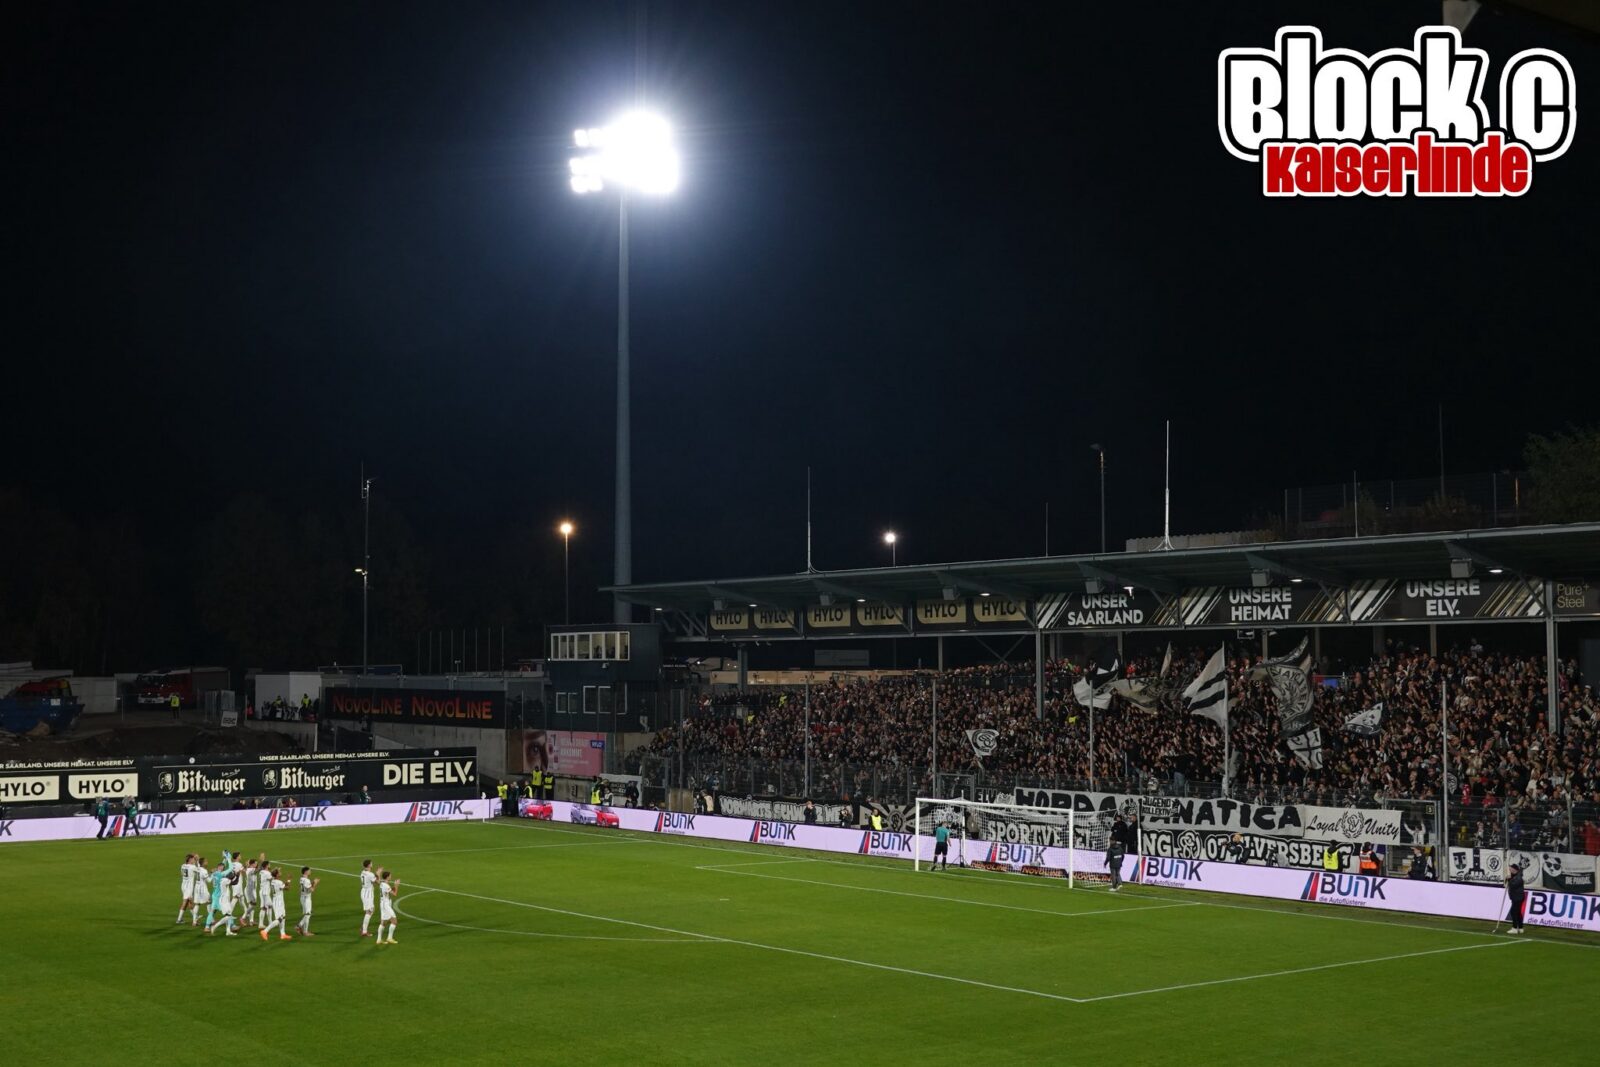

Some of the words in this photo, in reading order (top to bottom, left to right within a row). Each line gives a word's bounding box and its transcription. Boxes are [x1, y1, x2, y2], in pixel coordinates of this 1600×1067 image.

[1229, 587, 1292, 603] UNSERE
[1406, 580, 1480, 598] UNSERE
[1081, 594, 1128, 609] UNSER
[1557, 596, 1585, 608] Steel
[814, 607, 843, 622] HYLO
[924, 603, 957, 618] HYLO
[1067, 609, 1144, 626] SAARLAND
[1231, 604, 1292, 622] HEIMAT
[716, 612, 741, 625] HYLO
[280, 767, 345, 790] Bitburger
[383, 763, 424, 786] DIE
[430, 761, 474, 785] ELV.
[78, 779, 124, 794] HYLO
[177, 769, 246, 794] Bitburger
[0, 782, 45, 797] HYLO
[1306, 815, 1342, 836] Loyal
[1364, 818, 1399, 840] Unity
[1329, 897, 1367, 907] Autoflüsterer
[1539, 918, 1584, 929] Autoflüsterer
